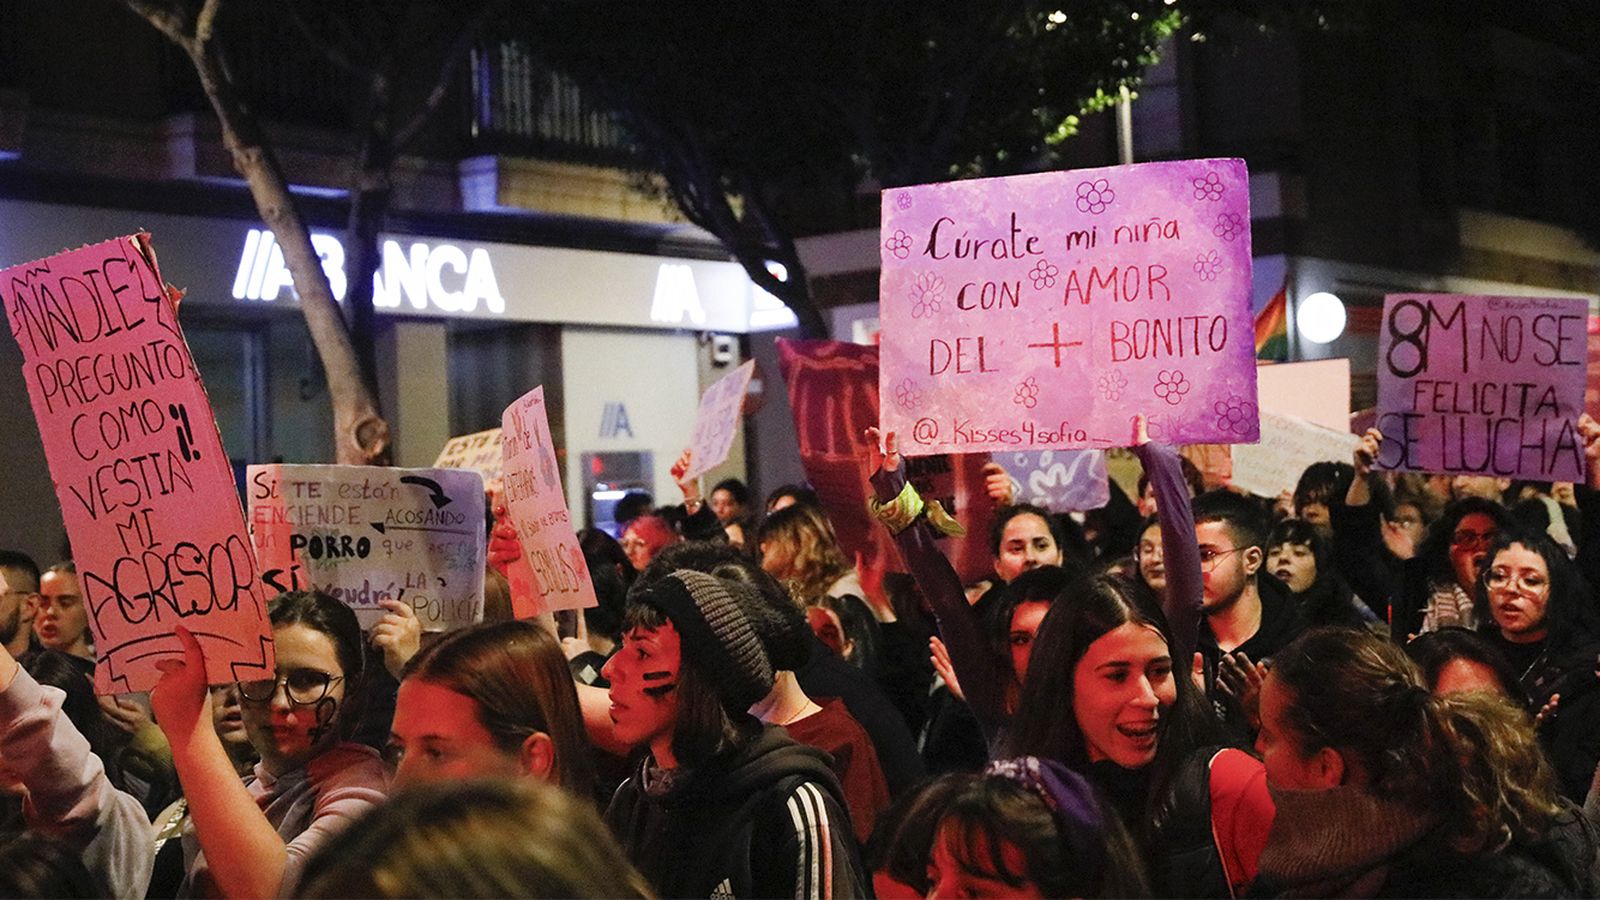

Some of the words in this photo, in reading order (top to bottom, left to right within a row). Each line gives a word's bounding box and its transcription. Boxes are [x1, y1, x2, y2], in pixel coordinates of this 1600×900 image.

[923, 212, 1044, 260] Cúrate
[1066, 224, 1097, 250] mi
[1114, 217, 1180, 242] niña
[17, 257, 146, 357] NADIE
[957, 280, 1021, 311] CON
[1063, 264, 1170, 306] AMOR
[930, 336, 999, 376] DEL
[1111, 315, 1227, 362] BONITO
[1386, 299, 1468, 378] 8M
[1479, 314, 1523, 364] NO
[1532, 313, 1581, 366] SE
[36, 340, 185, 414] PREGUNTO
[1413, 379, 1559, 418] FELICITA
[71, 399, 165, 461] COMO
[1376, 412, 1425, 471] SE
[1441, 416, 1582, 476] LUCHA
[69, 449, 195, 520] VESTIA
[253, 471, 278, 500] Si
[292, 482, 322, 499] TE
[338, 478, 400, 500] están
[116, 508, 162, 555] MI
[254, 505, 361, 526] ENCIENDE
[385, 509, 466, 525] ACOSANDO
[290, 533, 371, 561] PORRO
[382, 539, 414, 558] que
[83, 535, 263, 640] AGRESOR
[405, 572, 426, 590] LA
[412, 593, 480, 622] POLICÍA
